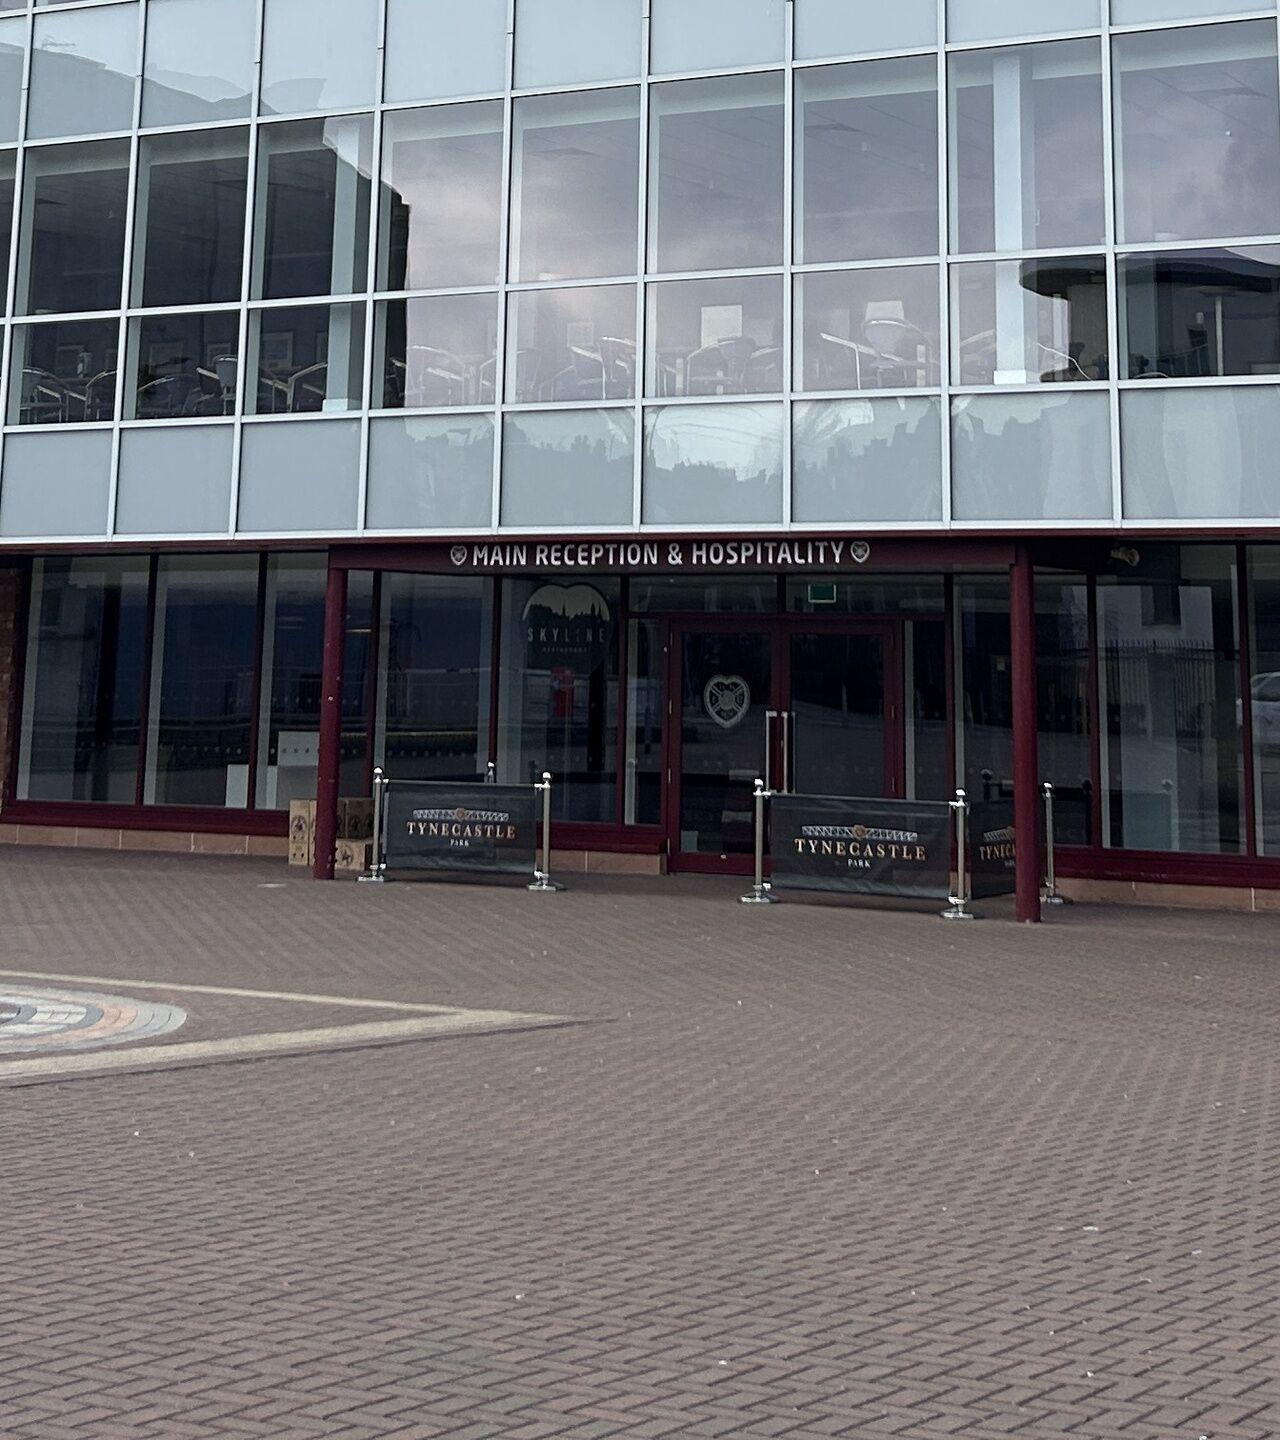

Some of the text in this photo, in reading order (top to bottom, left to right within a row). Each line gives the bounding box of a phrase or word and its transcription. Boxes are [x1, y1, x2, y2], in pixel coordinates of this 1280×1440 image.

[472, 540, 845, 567] MAIN RECEPTION & HOSPITALITY
[527, 627, 606, 643] SKYLINE
[406, 821, 517, 840] TYNECASTLE
[449, 838, 470, 847] PARK
[793, 838, 927, 861] TYNECASTLE
[847, 858, 872, 869] PARK
